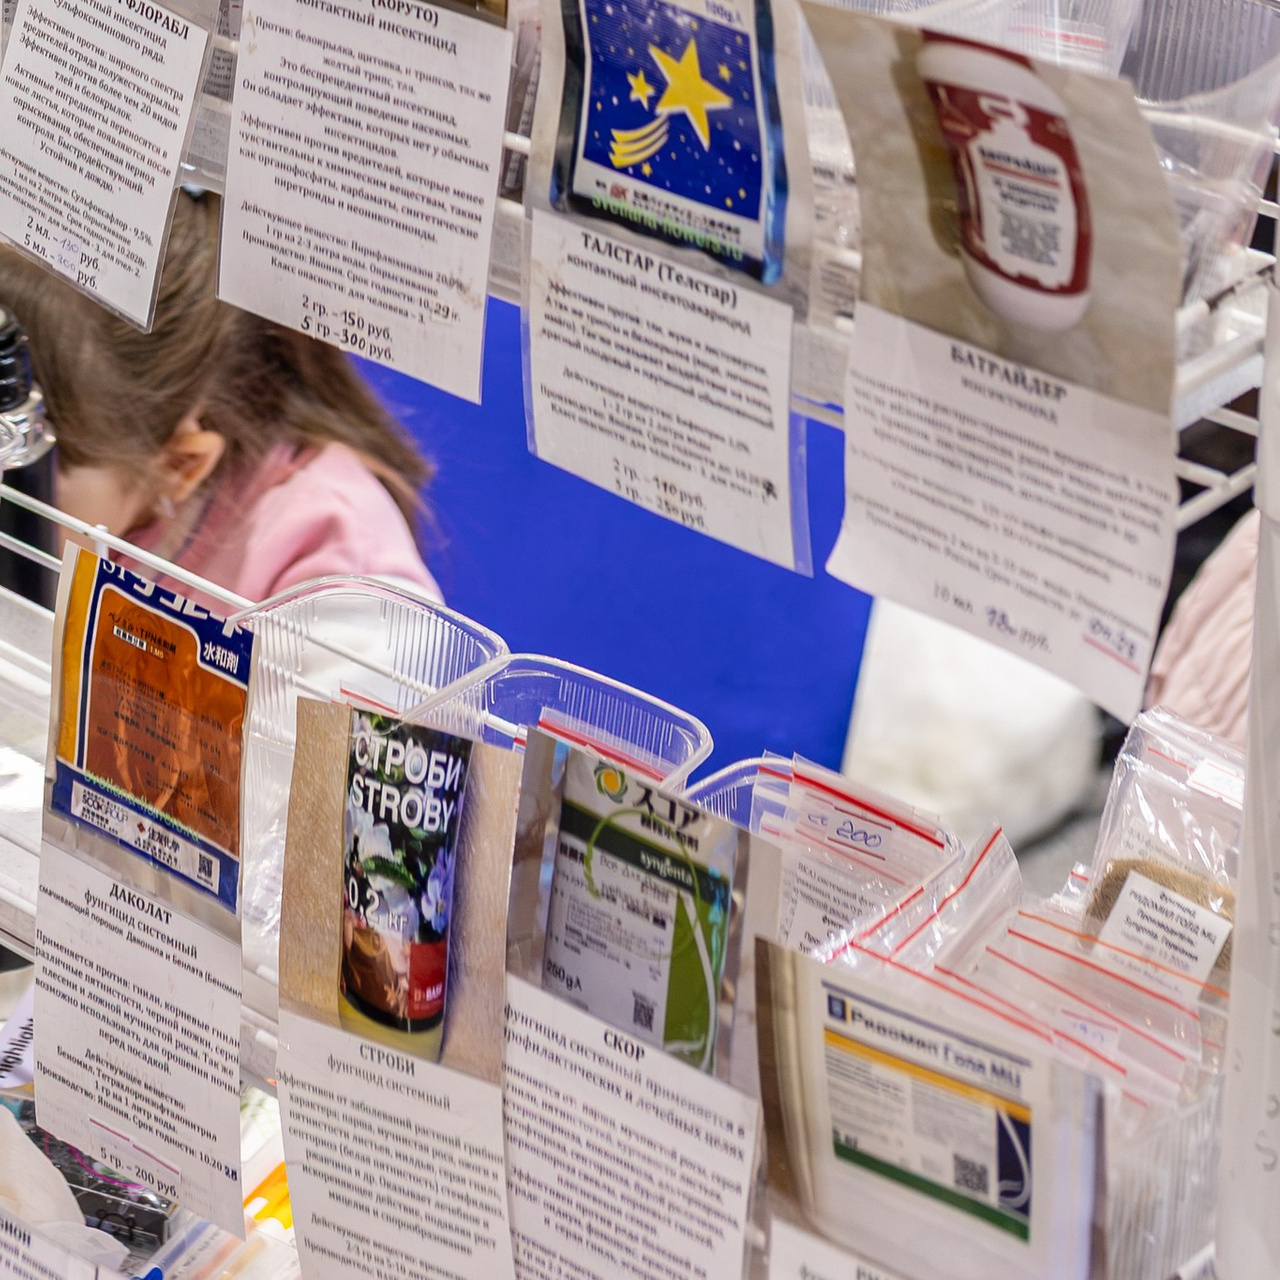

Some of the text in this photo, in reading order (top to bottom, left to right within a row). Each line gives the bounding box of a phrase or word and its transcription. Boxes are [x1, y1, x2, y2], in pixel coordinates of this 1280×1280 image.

[113, 11, 166, 49] инсектицид
[379, 19, 456, 55] инсектицид
[141, 45, 165, 64] ряда.
[40, 140, 77, 171] Устойчив
[84, 170, 113, 193] дождю.
[581, 232, 737, 308] ТАЛСТАР (Телстар)
[202, 641, 239, 675] 水和剤
[355, 731, 463, 792] СТРОБИ
[352, 774, 455, 833] STROBY
[640, 849, 693, 884] syngenta
[109, 883, 171, 924] ДАКОЛАТ
[84, 891, 197, 959] фунгицид системный
[360, 1044, 414, 1077] СТРОБИ
[604, 1031, 644, 1061] СКОР
[327, 1054, 449, 1111] фунгицид системный
[109, 1153, 124, 1170] гр.
[134, 1164, 155, 1186] 200
[156, 1178, 179, 1200] руб.
